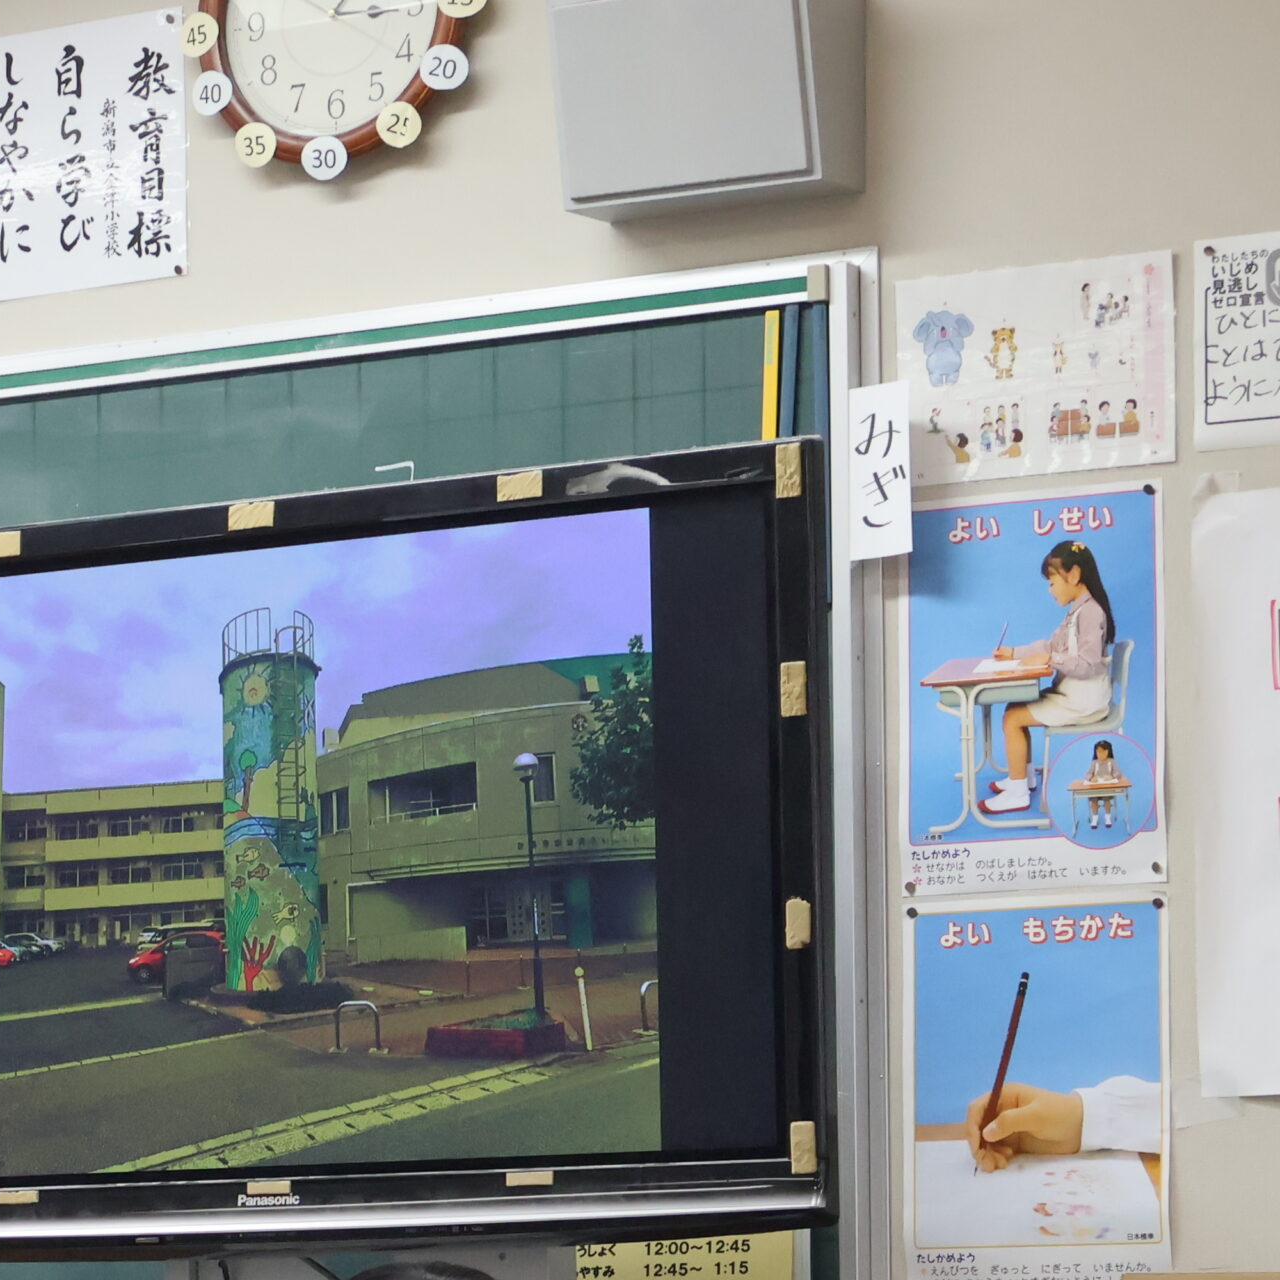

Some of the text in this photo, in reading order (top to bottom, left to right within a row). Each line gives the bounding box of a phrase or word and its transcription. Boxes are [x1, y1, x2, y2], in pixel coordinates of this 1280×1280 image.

[186, 24, 208, 46] 45
[247, 12, 266, 42] 9
[395, 32, 415, 63] 4
[260, 54, 278, 86] 8
[428, 56, 457, 79] 20
[199, 84, 222, 104] 40
[367, 71, 385, 102] 5
[290, 83, 307, 114] 7
[327, 89, 346, 119] 6
[55, 44, 95, 252] 自ら学び
[126, 46, 176, 258] 教育目標
[244, 135, 266, 157] 35
[311, 149, 337, 169] 30
[1211, 249, 1269, 264] わたしたちの
[1211, 261, 1259, 278] いじめ
[1212, 277, 1258, 295] 見逃し
[1211, 291, 1266, 309] ゼロ宣言
[1204, 375, 1280, 406] ように
[854, 412, 908, 528] みぎ
[948, 505, 1114, 544] よい しせい
[911, 848, 971, 861] たしかめよう
[926, 856, 1053, 873] せなかは のばしましたか。
[927, 864, 1128, 886] おなかと つくえが はなれて いますか。
[940, 912, 1135, 950] よい もちかた
[237, 1193, 300, 1207] Panasonic
[916, 1252, 976, 1264] たしかめよう
[576, 1265, 615, 1279] やすみ
[714, 1260, 749, 1275] 1:15
[930, 1266, 979, 1276] えんぴつを
[990, 1265, 1030, 1275] ぎゅっと
[1041, 1263, 1082, 1274] にぎって
